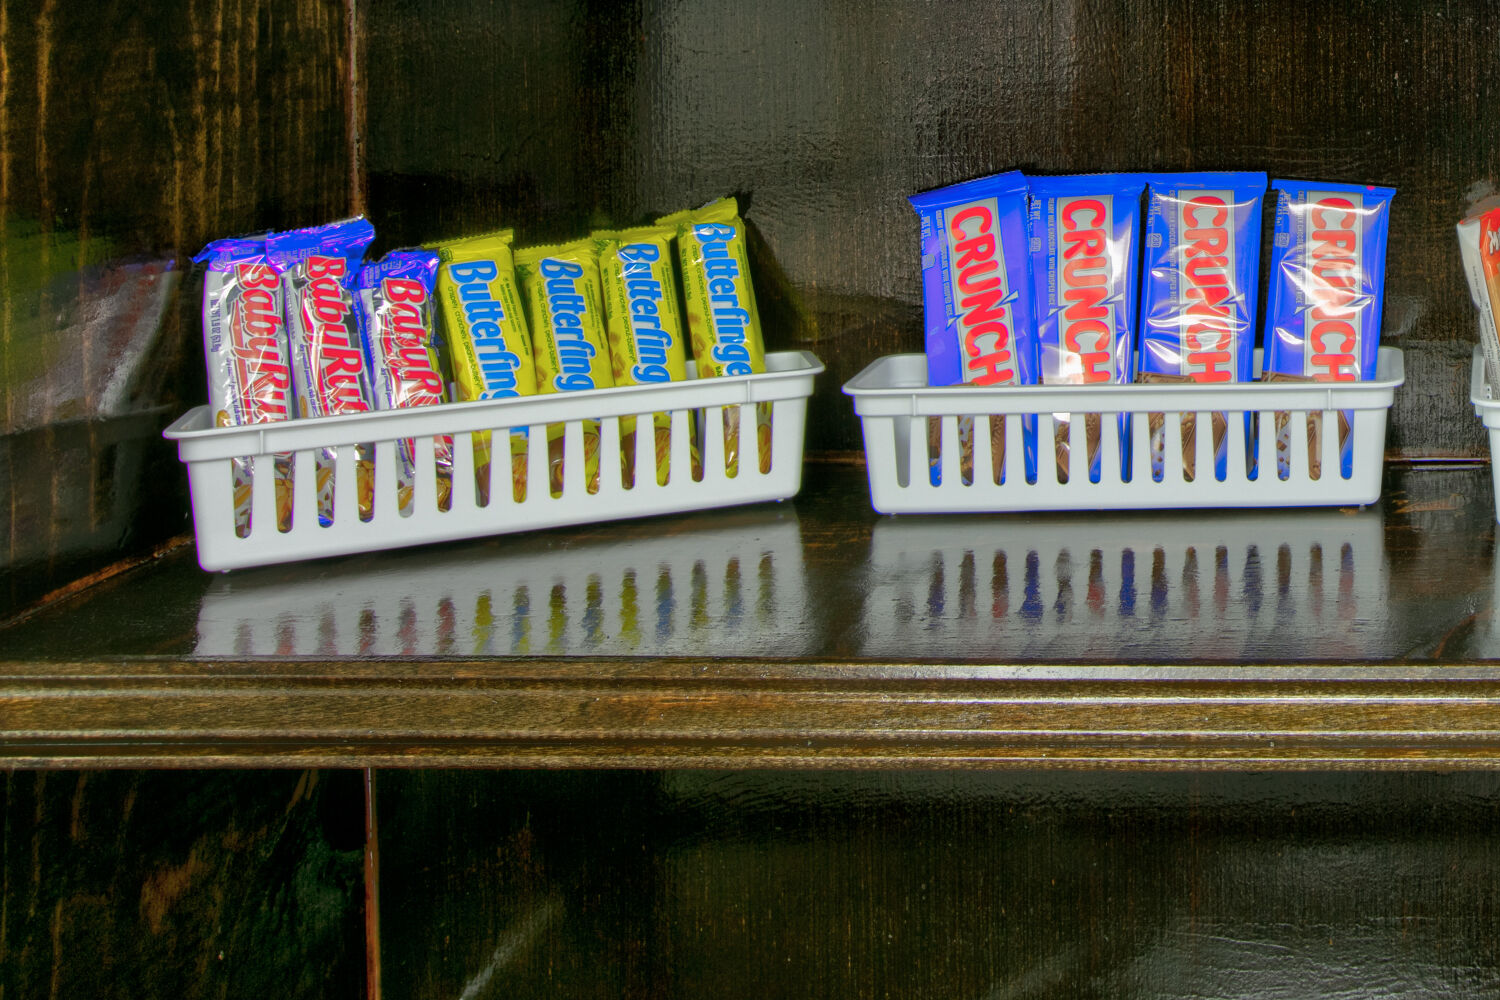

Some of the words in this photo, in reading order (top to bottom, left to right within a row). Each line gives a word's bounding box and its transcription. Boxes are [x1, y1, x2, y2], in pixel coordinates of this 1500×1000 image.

[951, 205, 1014, 386] CRUNCH
[1061, 199, 1112, 385] CRUNCH
[1182, 195, 1232, 383] CRUNCH
